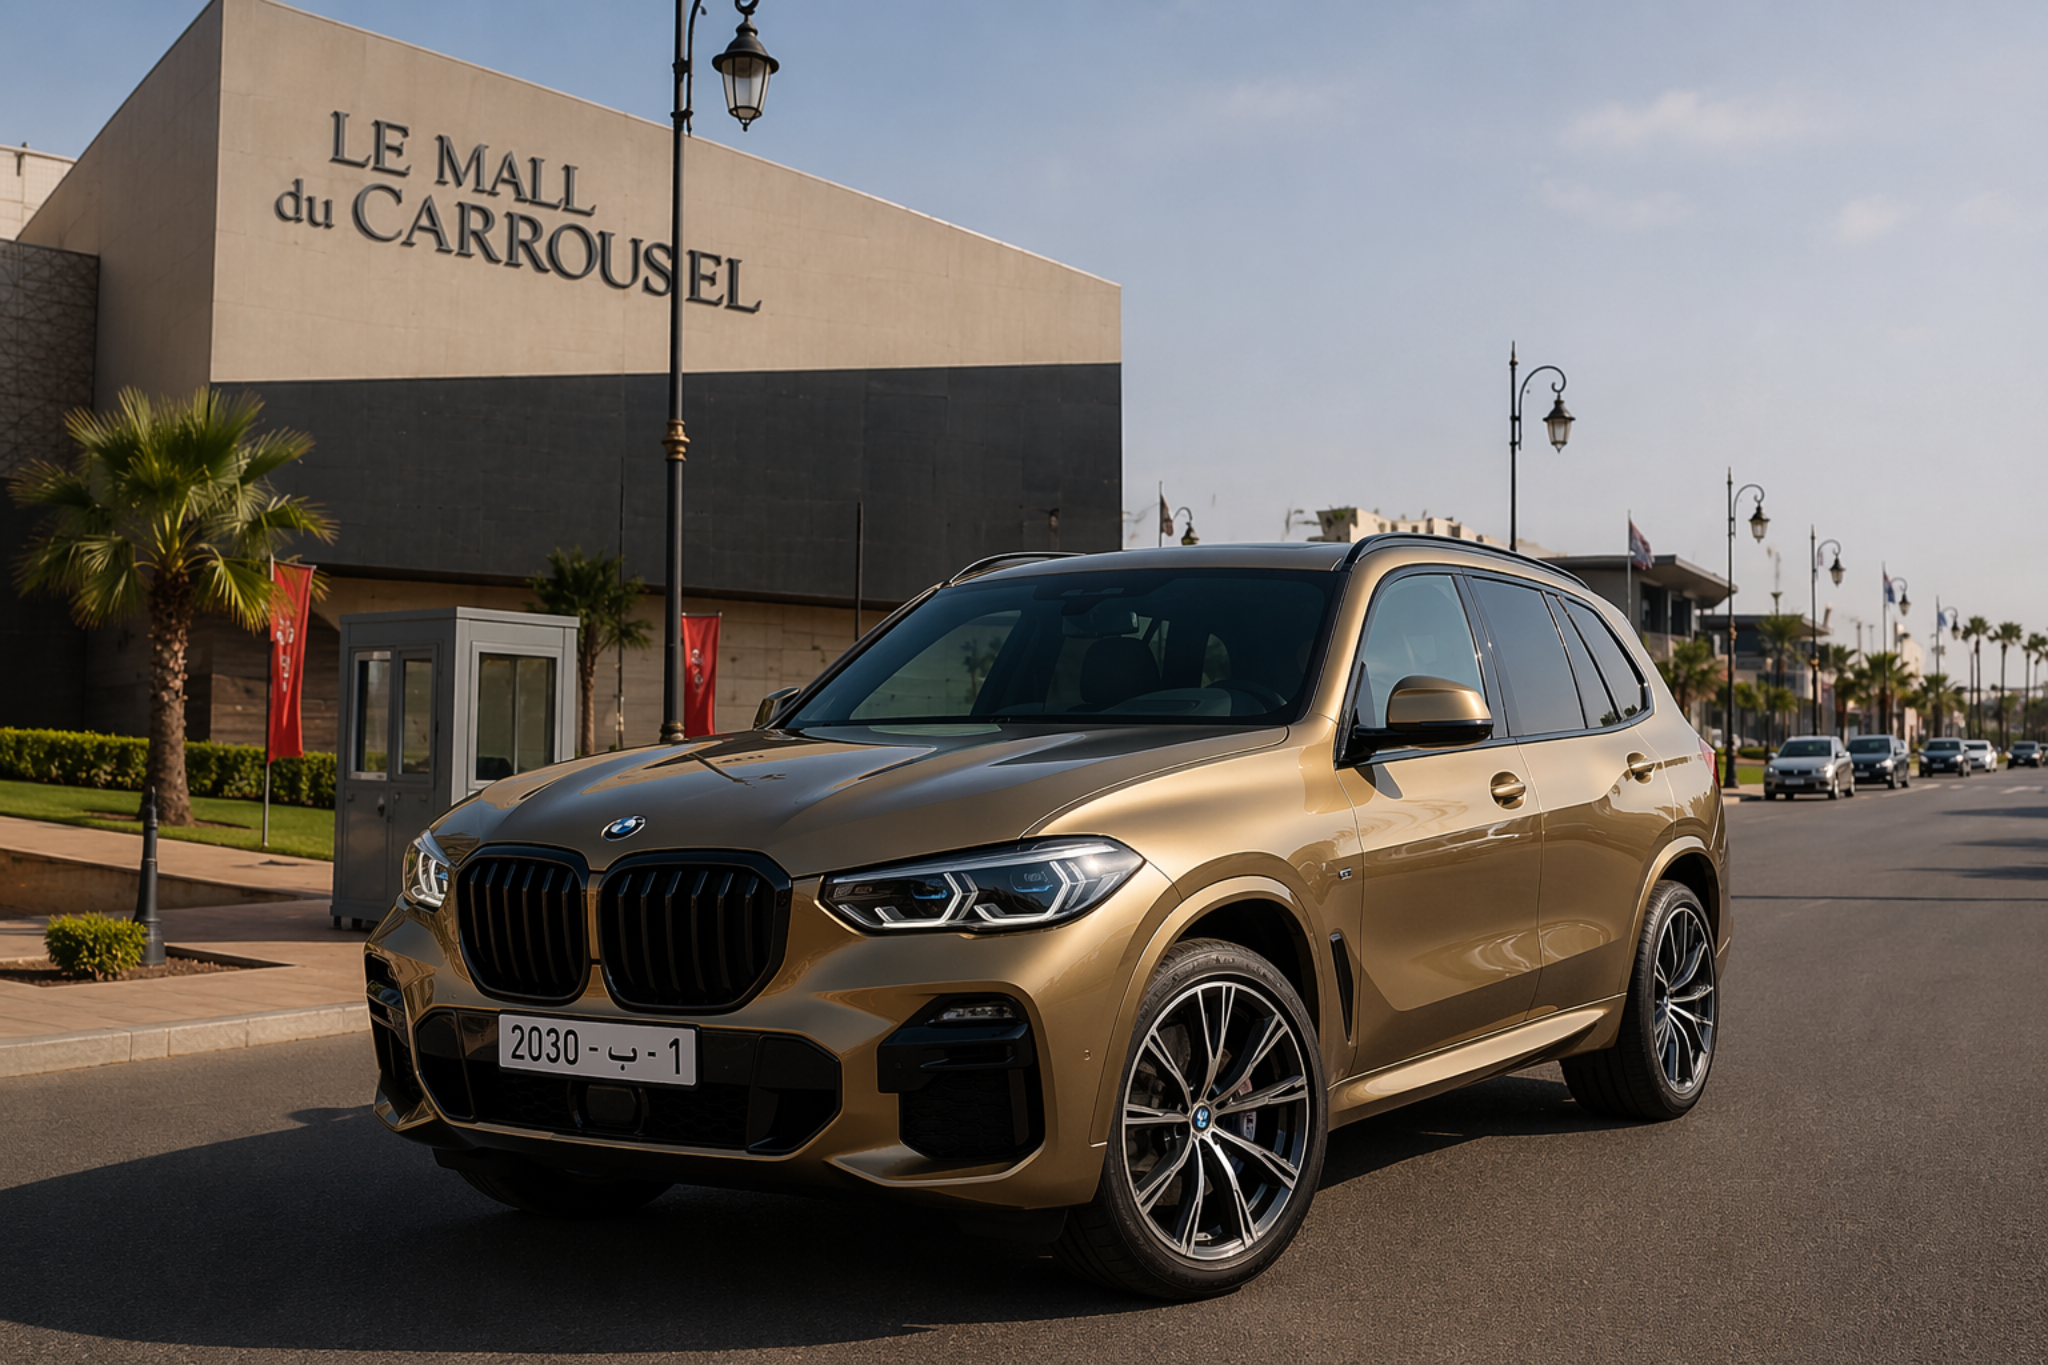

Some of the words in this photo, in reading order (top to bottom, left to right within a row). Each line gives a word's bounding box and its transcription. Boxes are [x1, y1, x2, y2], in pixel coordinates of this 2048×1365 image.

[329, 109, 412, 178] LE
[433, 133, 597, 218] MALL
[273, 177, 335, 231] du
[350, 182, 763, 316] CARROUSEL
[510, 1023, 580, 1066] 2030
[668, 1037, 681, 1076] 1
